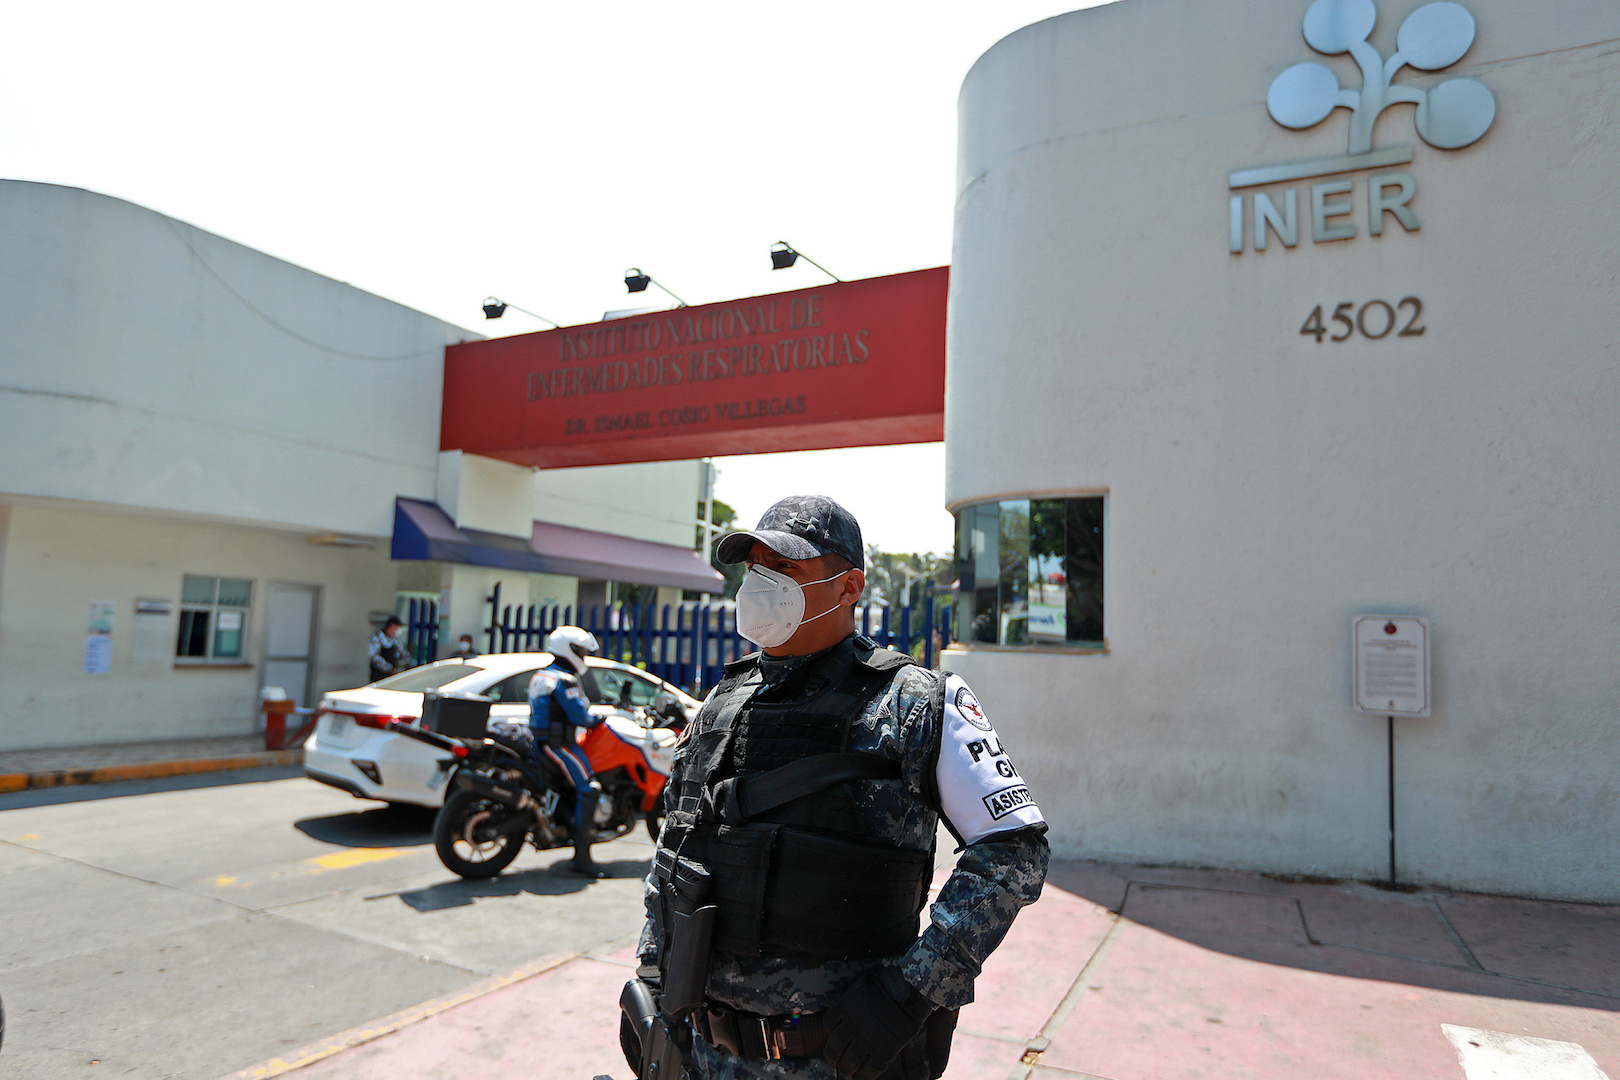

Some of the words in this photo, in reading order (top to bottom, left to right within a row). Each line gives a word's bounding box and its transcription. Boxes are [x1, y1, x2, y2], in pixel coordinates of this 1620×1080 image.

[1229, 173, 1421, 256] INER
[558, 319, 661, 362] INSTITUTO
[666, 302, 782, 347] NACIONAL
[789, 294, 822, 330] DE
[1300, 297, 1425, 342] 4502
[526, 353, 682, 401] ENFERMEDADES
[687, 329, 869, 382] RESPIRATORIAS
[593, 411, 653, 432] ISMAEL
[714, 395, 806, 420] VILLEGAS
